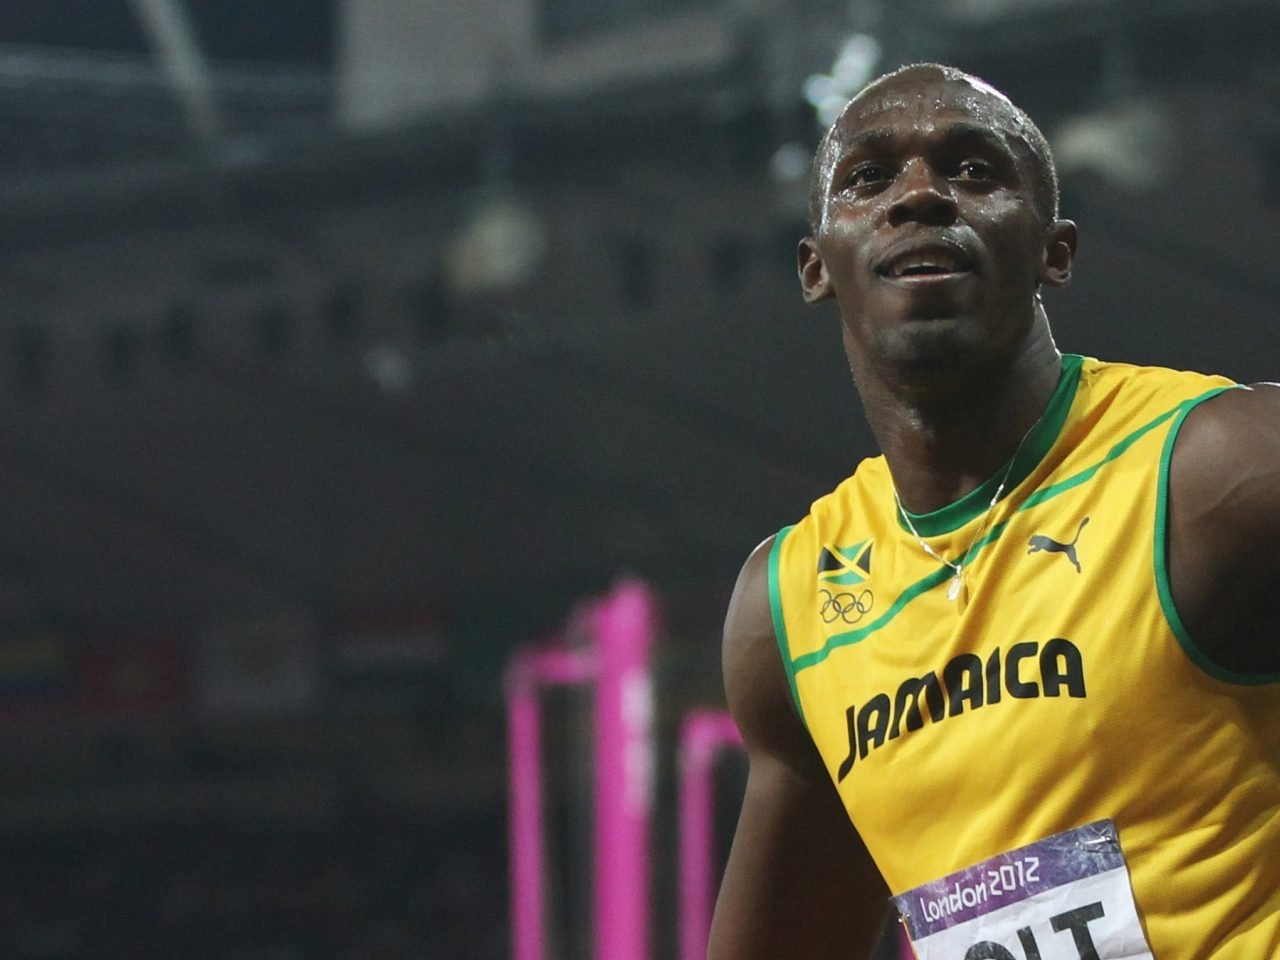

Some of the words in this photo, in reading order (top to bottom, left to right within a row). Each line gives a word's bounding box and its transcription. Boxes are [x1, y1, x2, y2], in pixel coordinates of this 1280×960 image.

[838, 638, 1086, 783] JAMAICA
[920, 880, 987, 922] London
[988, 857, 1039, 895] 2012
